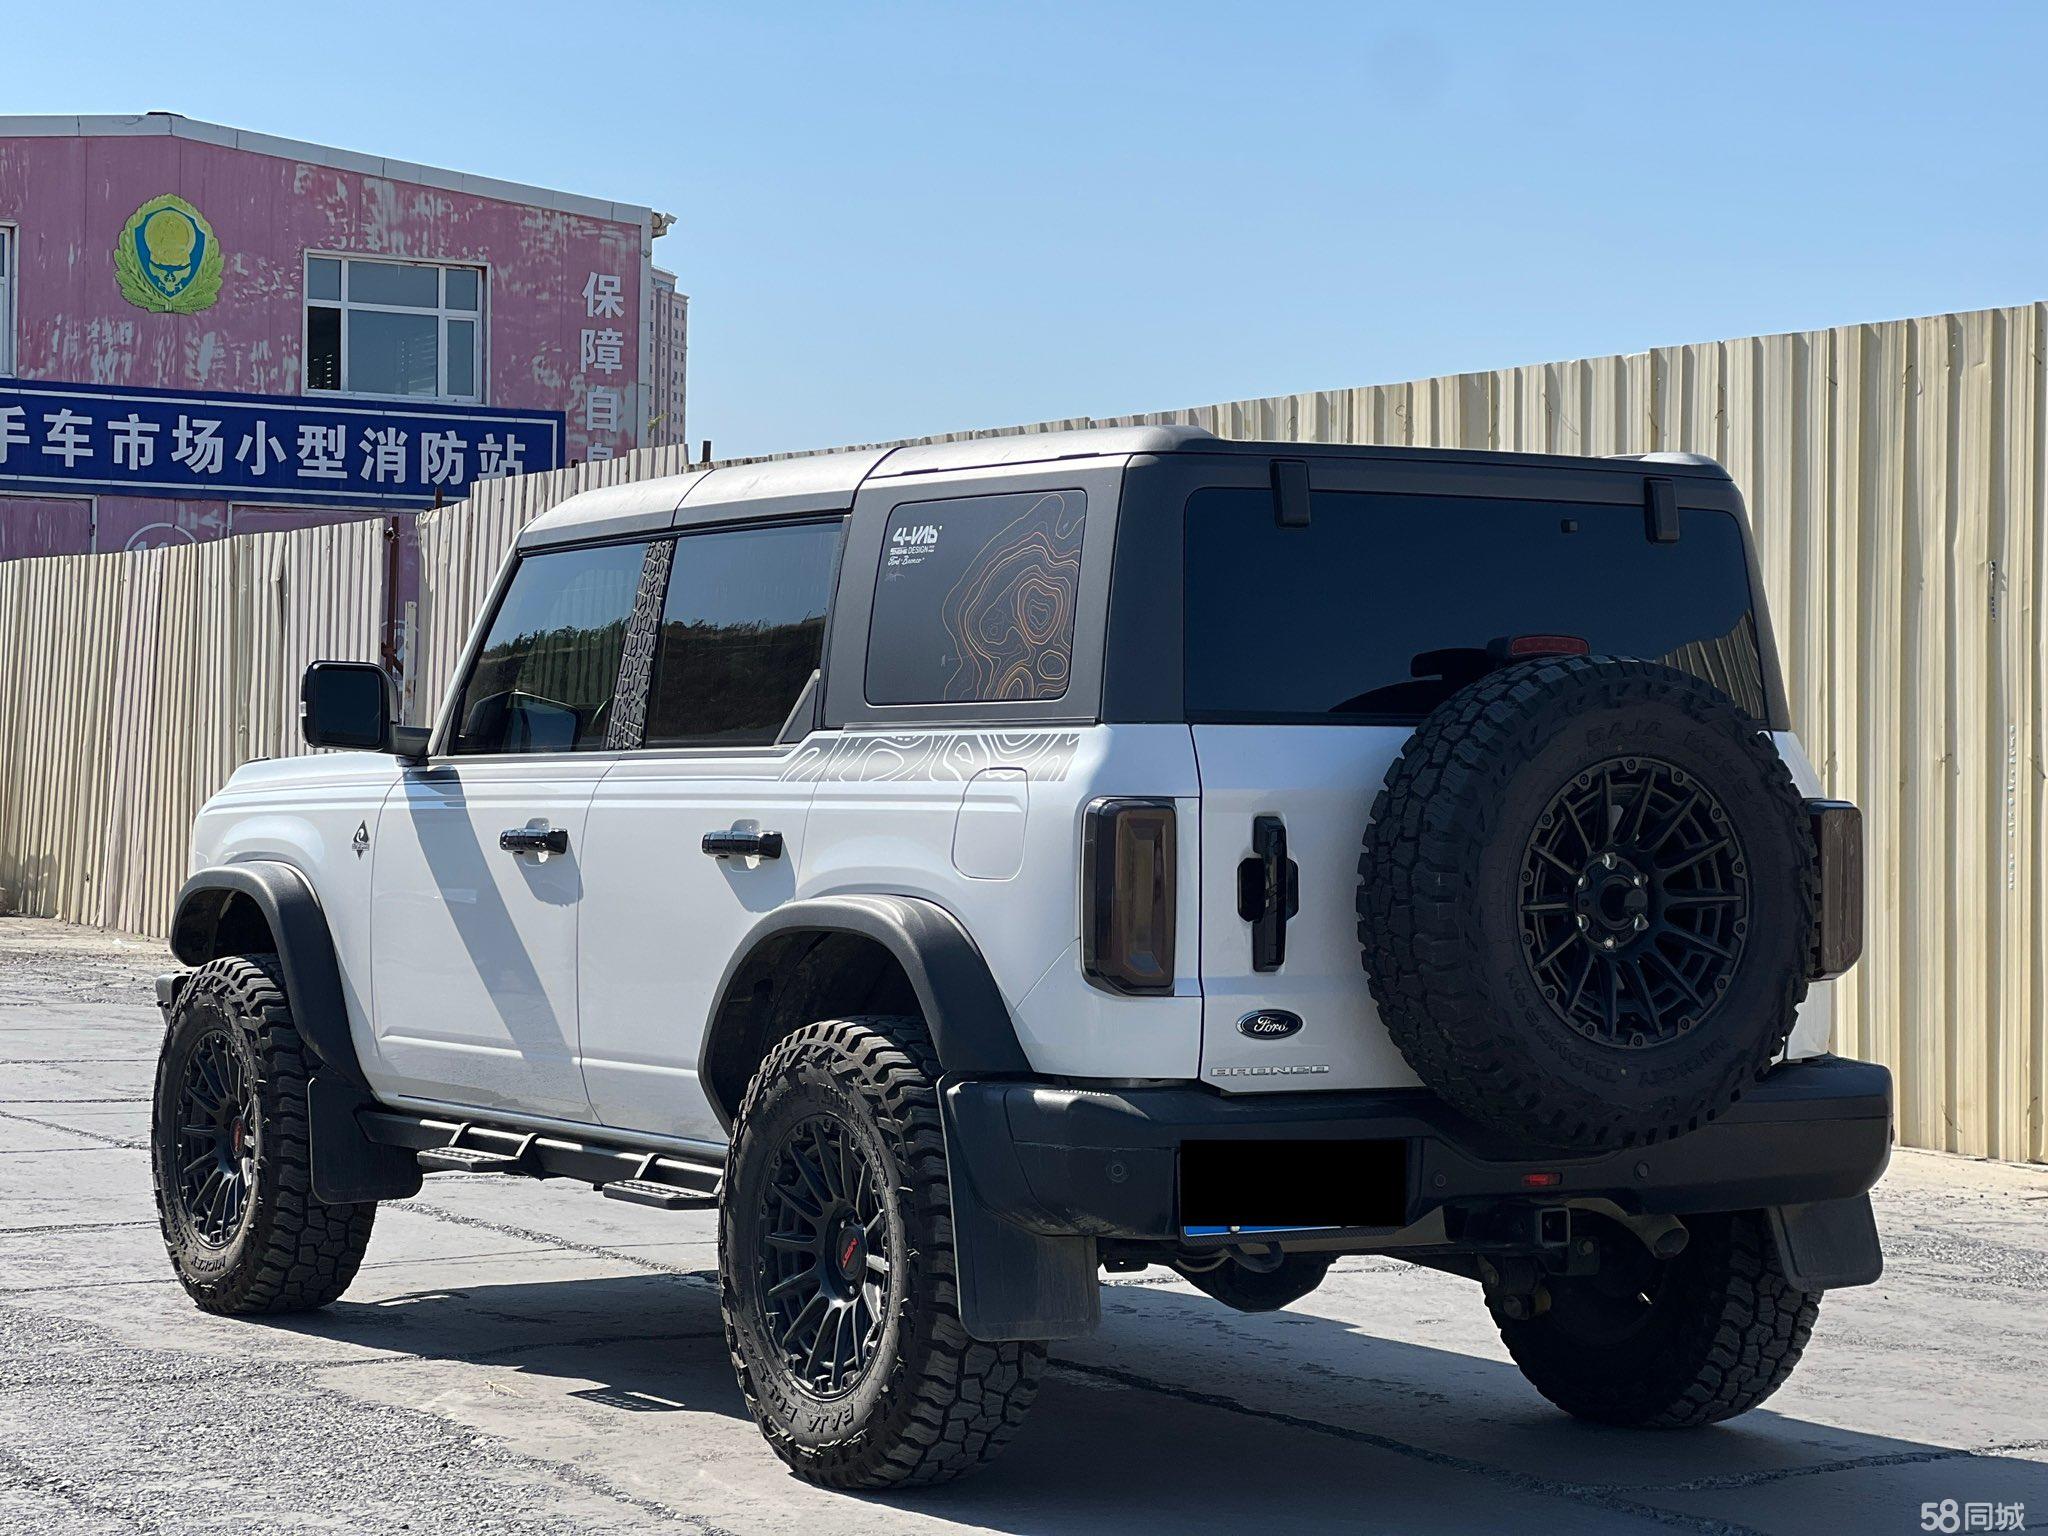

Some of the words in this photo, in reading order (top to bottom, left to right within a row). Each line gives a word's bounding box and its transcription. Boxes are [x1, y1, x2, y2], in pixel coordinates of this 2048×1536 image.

[581, 272, 625, 462] 保障自
[0, 406, 526, 485] 手车市场小型消防站
[1252, 1016, 1289, 1032] Ford
[1211, 1065, 1329, 1076] BRONCO
